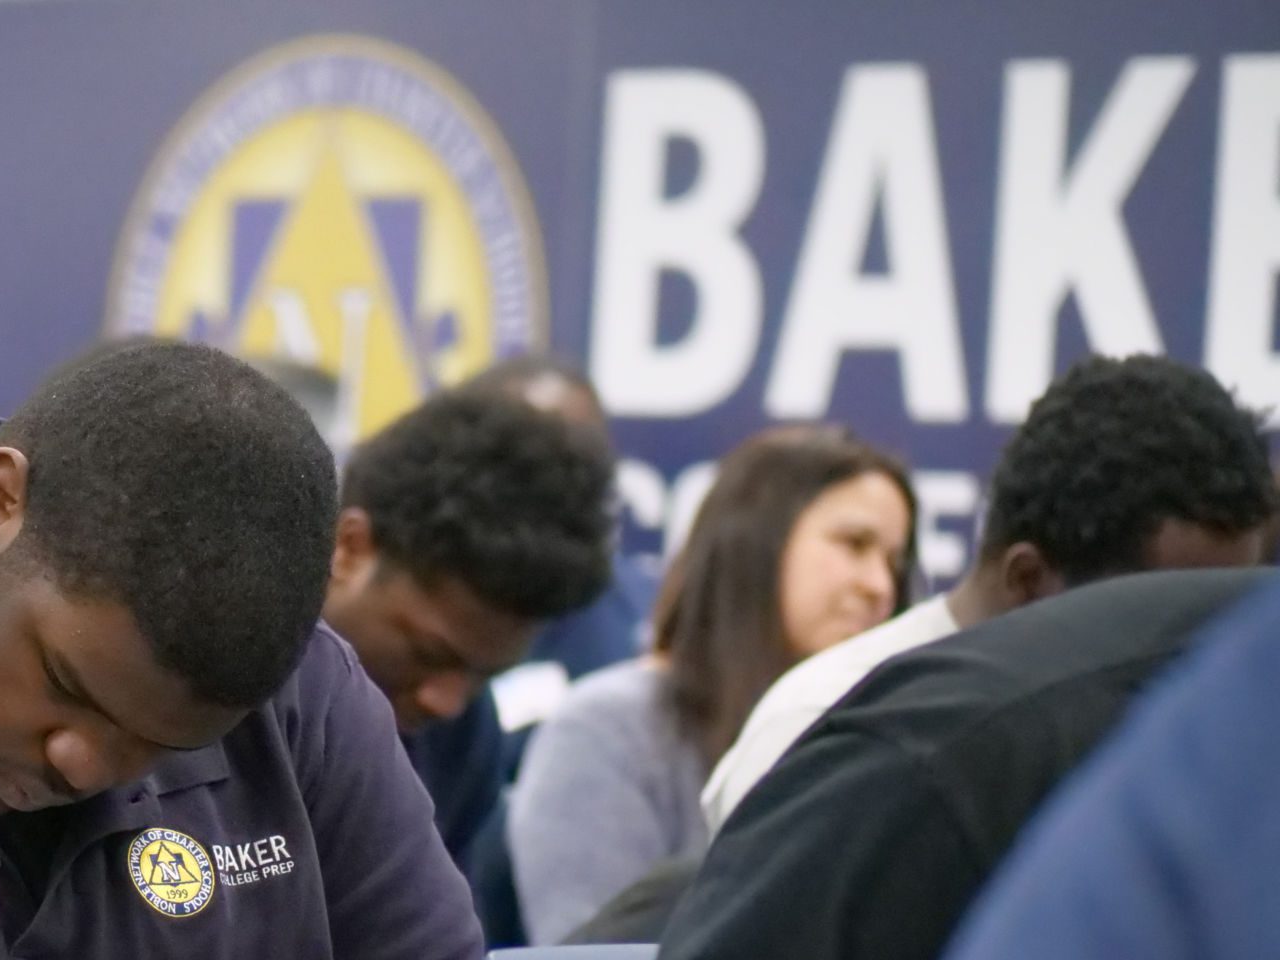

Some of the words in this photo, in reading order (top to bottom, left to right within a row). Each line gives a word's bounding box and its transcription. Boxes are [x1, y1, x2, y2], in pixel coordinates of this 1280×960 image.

[147, 830, 163, 841] OF
[130, 837, 150, 886] NETWORK
[164, 831, 209, 869] CHARTER
[212, 835, 291, 872] BAKER
[158, 862, 181, 882] N
[262, 861, 295, 879] PREP
[142, 887, 177, 914] NOBLE
[166, 889, 189, 900] 1999
[183, 870, 212, 913] SCHOOLS
